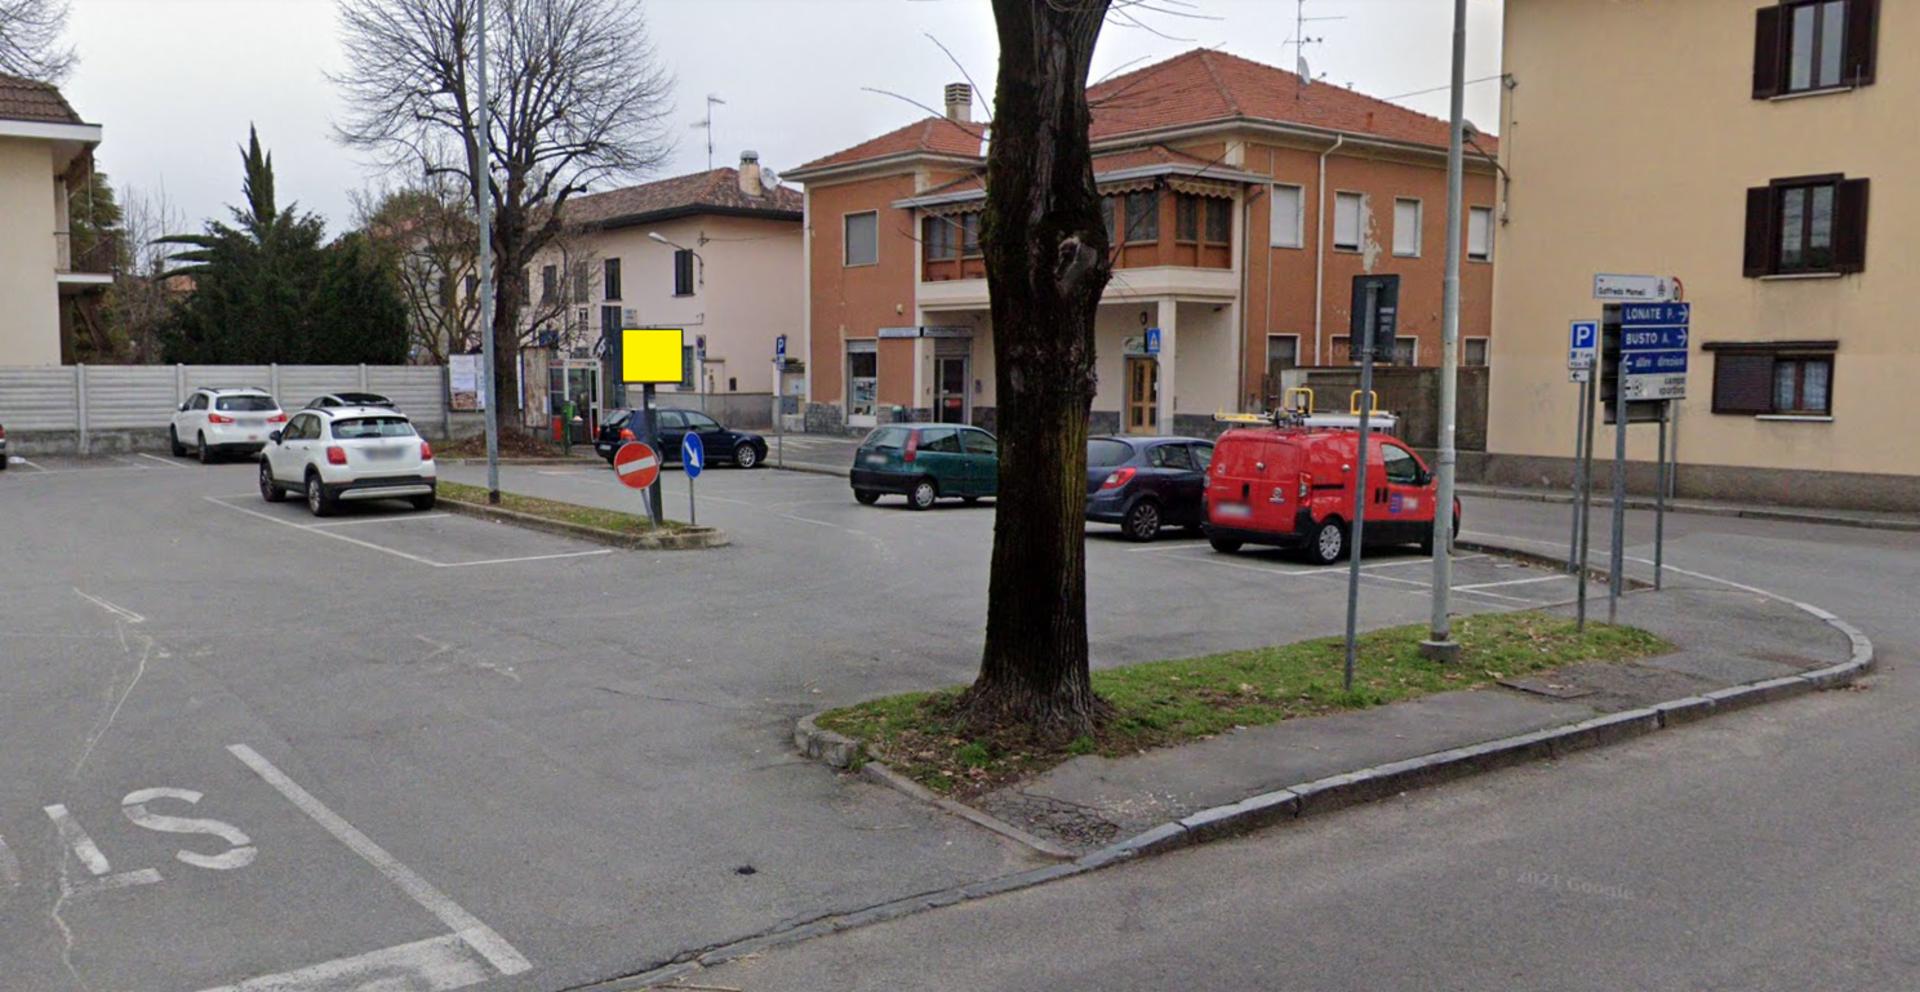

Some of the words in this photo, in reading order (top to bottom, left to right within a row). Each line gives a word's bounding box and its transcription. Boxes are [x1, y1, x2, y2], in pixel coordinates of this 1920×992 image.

[1625, 307, 1661, 321] LONATE
[1576, 325, 1591, 347] P
[1625, 331, 1658, 345] BUSTO
[777, 338, 785, 353] P
